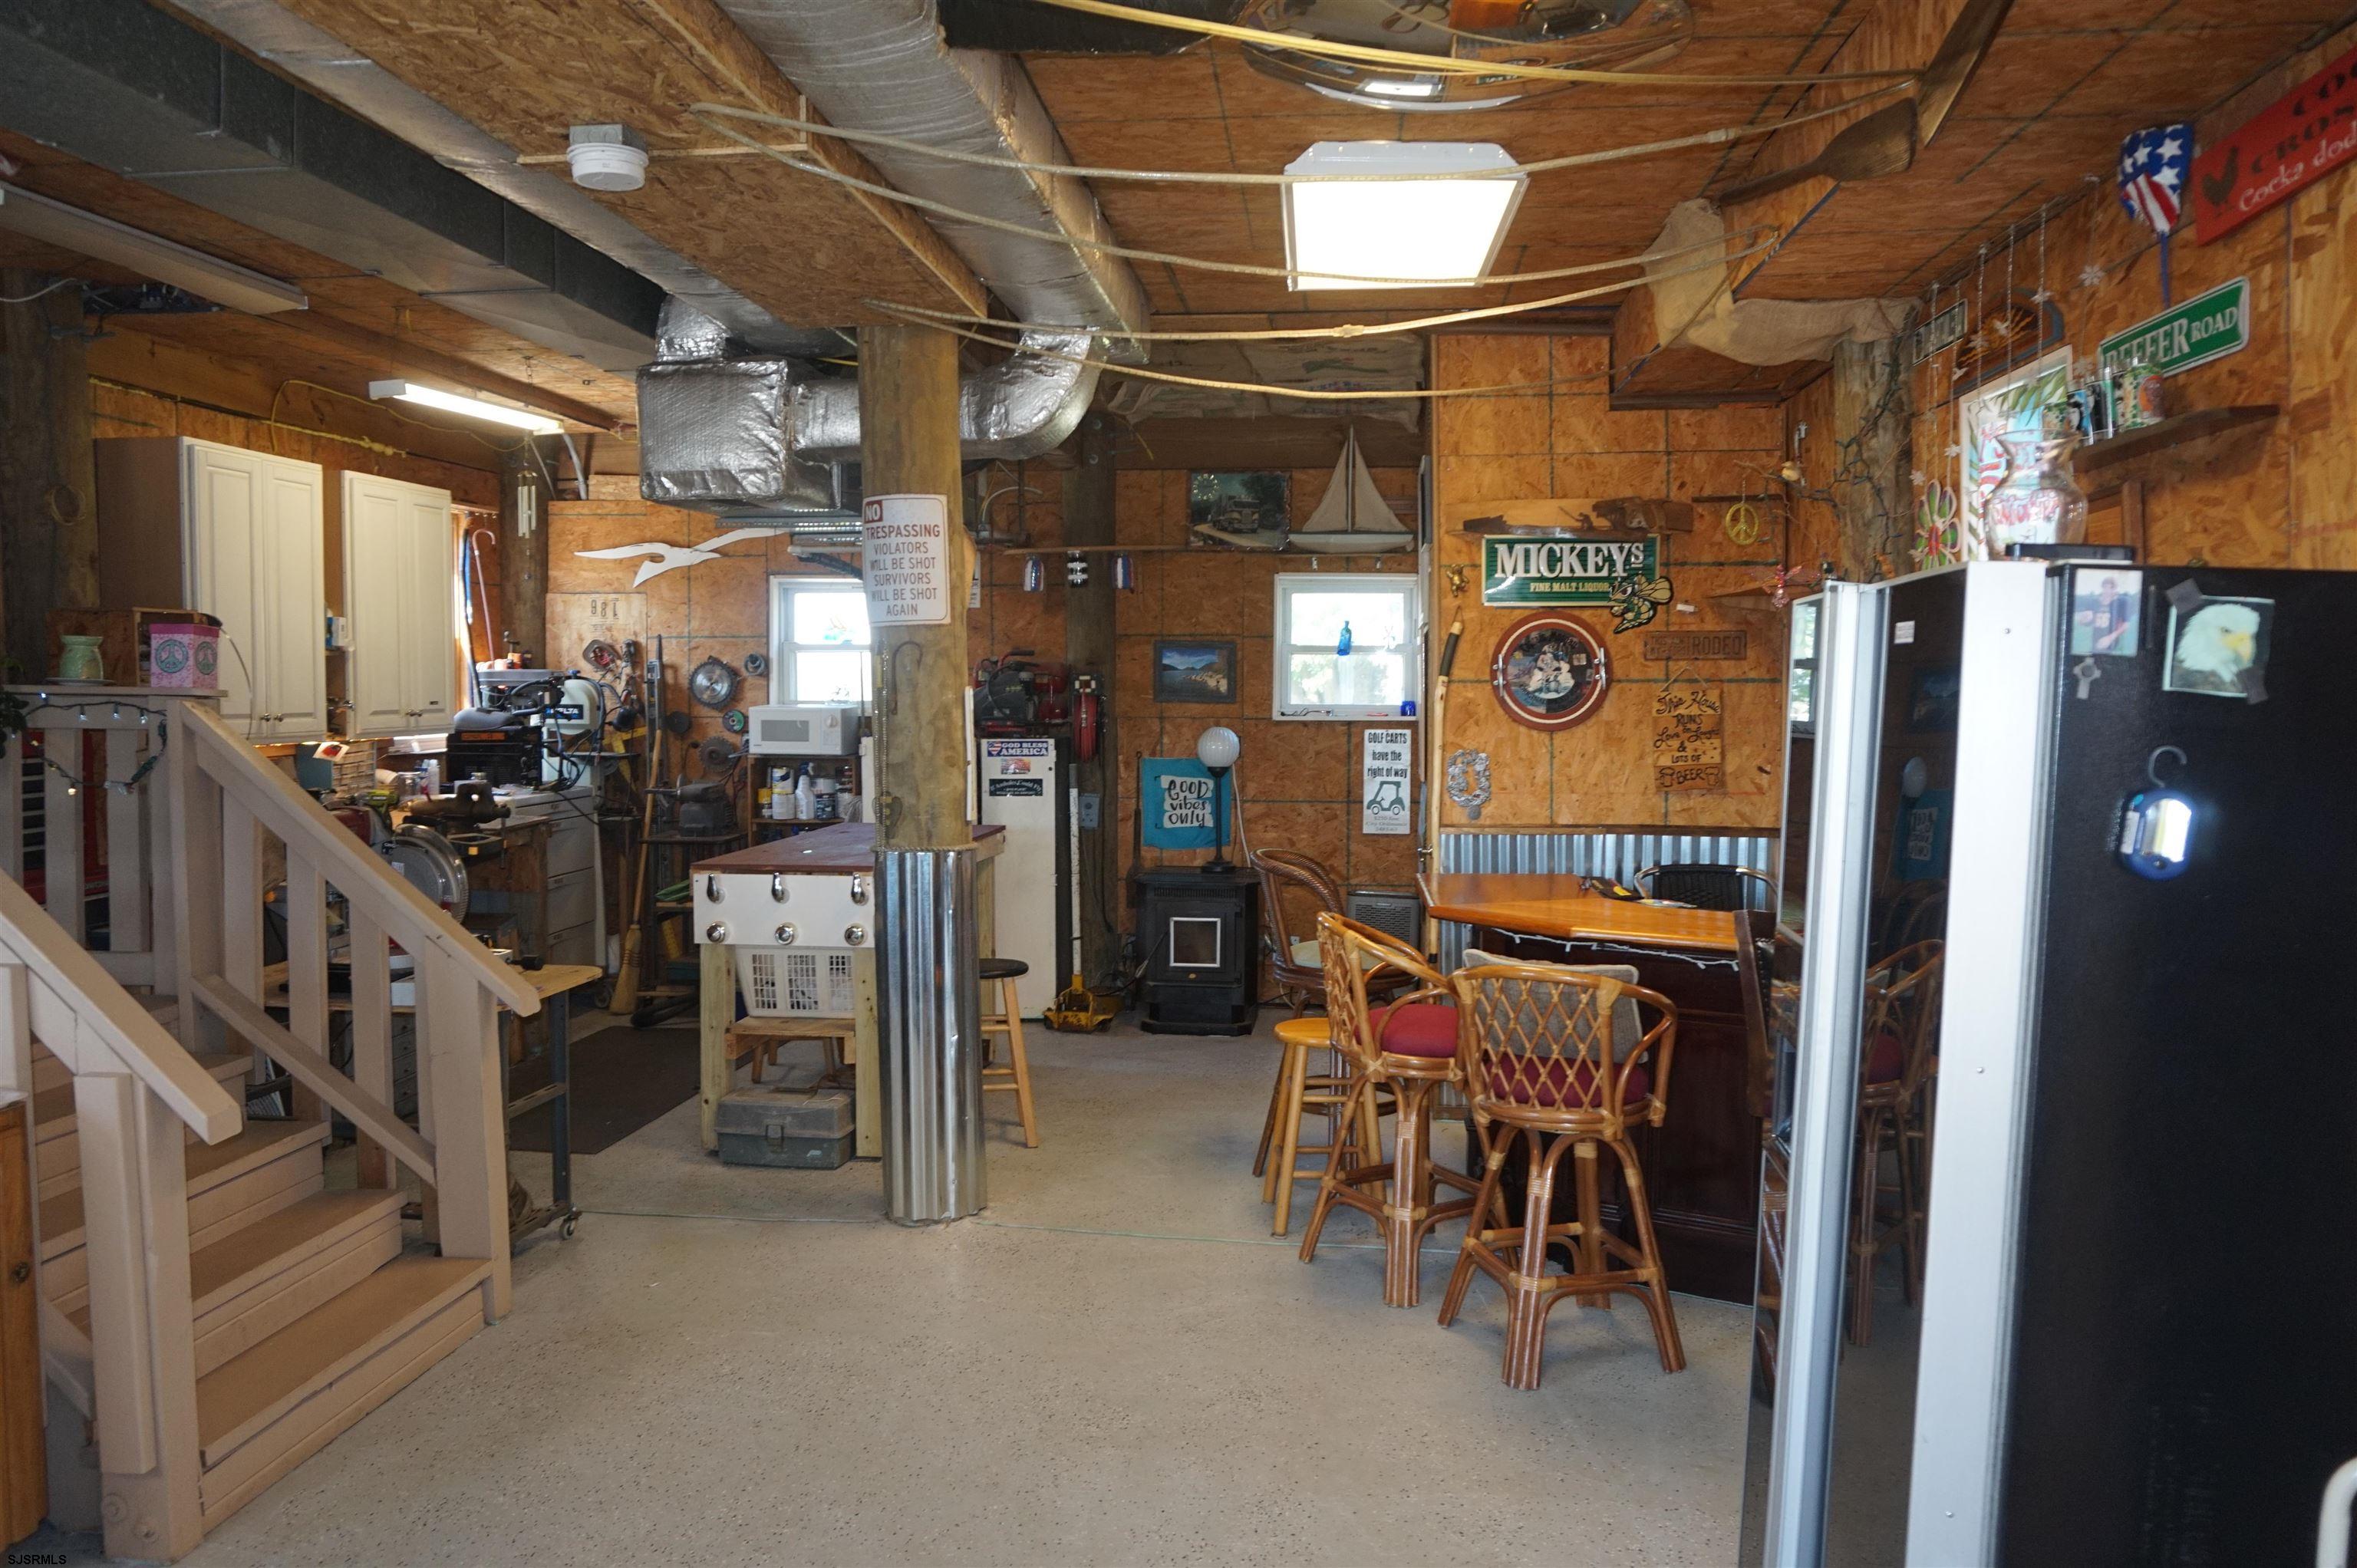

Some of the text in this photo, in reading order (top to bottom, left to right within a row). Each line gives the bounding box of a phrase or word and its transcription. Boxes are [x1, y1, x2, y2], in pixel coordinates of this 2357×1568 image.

[2191, 308, 2238, 343] ROAD
[865, 504, 881, 522] NO
[866, 525, 941, 540] TRESPASSING
[874, 542, 928, 555] VIOLATORS
[870, 557, 936, 572] WILL BE SHOT
[875, 572, 931, 587] SURVIVORS
[1530, 582, 1551, 592] FINE
[1554, 582, 1576, 592] MALT
[872, 588, 938, 602] WILL BE SHOT
[886, 603, 918, 616] AGAIN
[1693, 636, 1742, 655] RODEO
[1656, 692, 1687, 715] This
[1368, 732, 1407, 744] GOLF CARTS
[1372, 749, 1403, 761] have the
[1691, 754, 1702, 763] OF
[1367, 766, 1408, 779] right of way
[1676, 768, 1706, 785] BEER
[1168, 779, 1209, 800] GOOD
[1170, 796, 1206, 811] vibes
[1169, 810, 1205, 828] only
